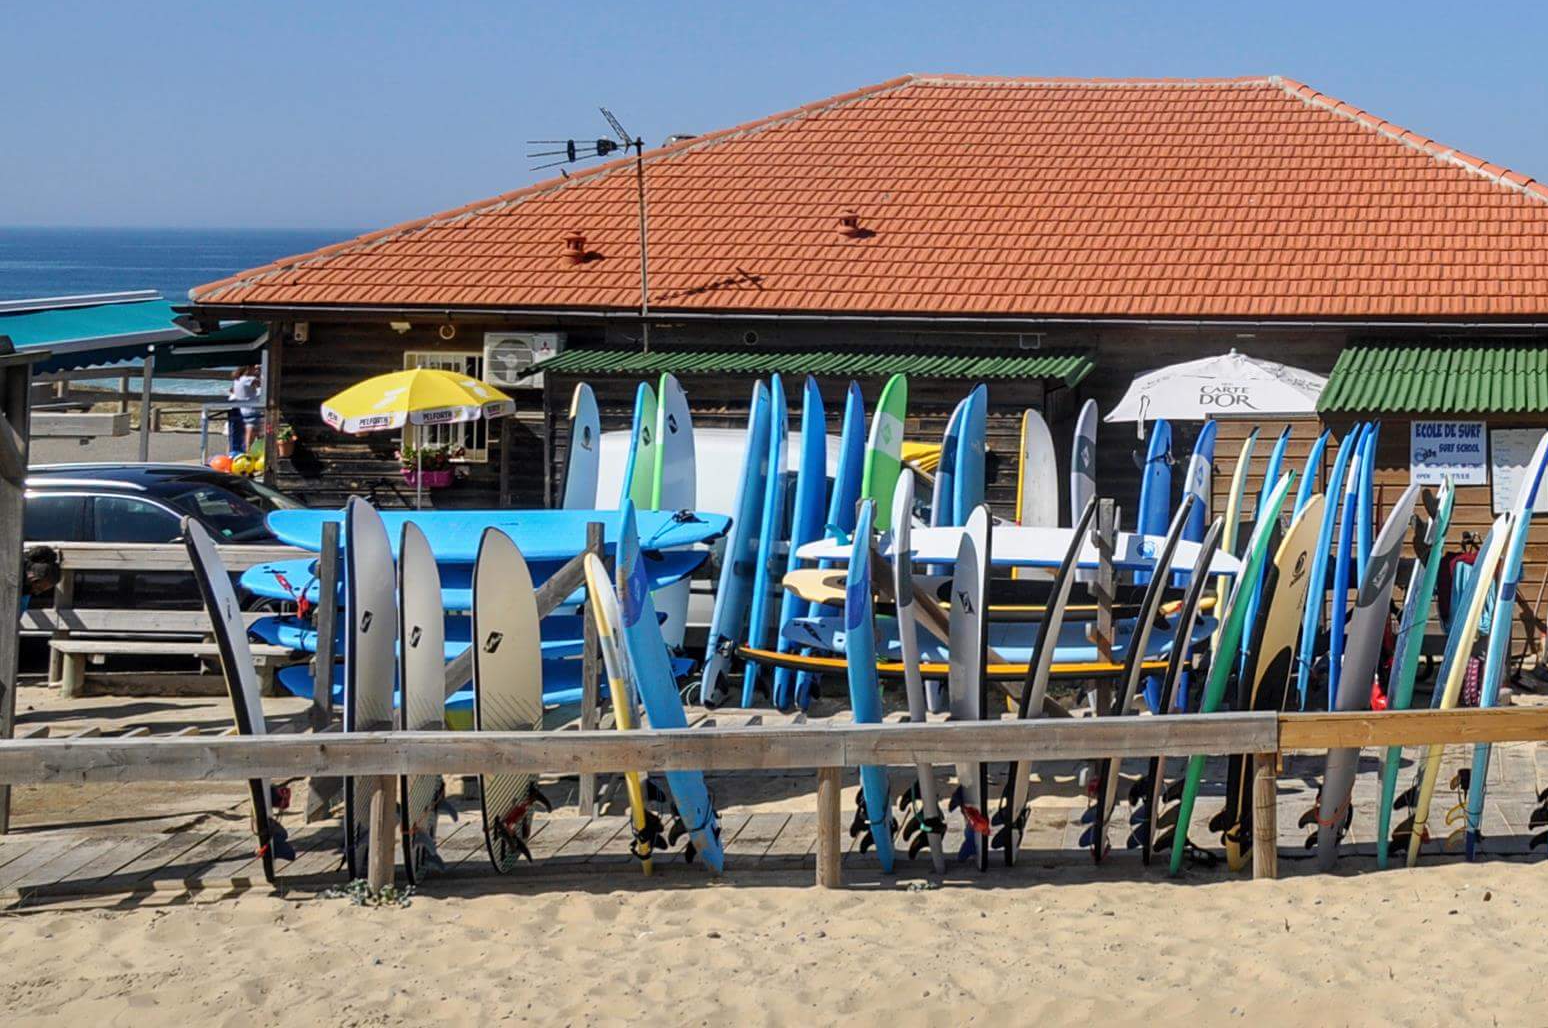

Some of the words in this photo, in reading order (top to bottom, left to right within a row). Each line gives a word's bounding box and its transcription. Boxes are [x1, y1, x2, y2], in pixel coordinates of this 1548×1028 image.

[1200, 385, 1249, 394] CARTE
[1415, 423, 1442, 438] ECOLE
[1444, 423, 1457, 438] DE
[1458, 423, 1482, 438] SURF
[1439, 443, 1455, 453] SURF
[1456, 443, 1480, 453] SCHOOL
